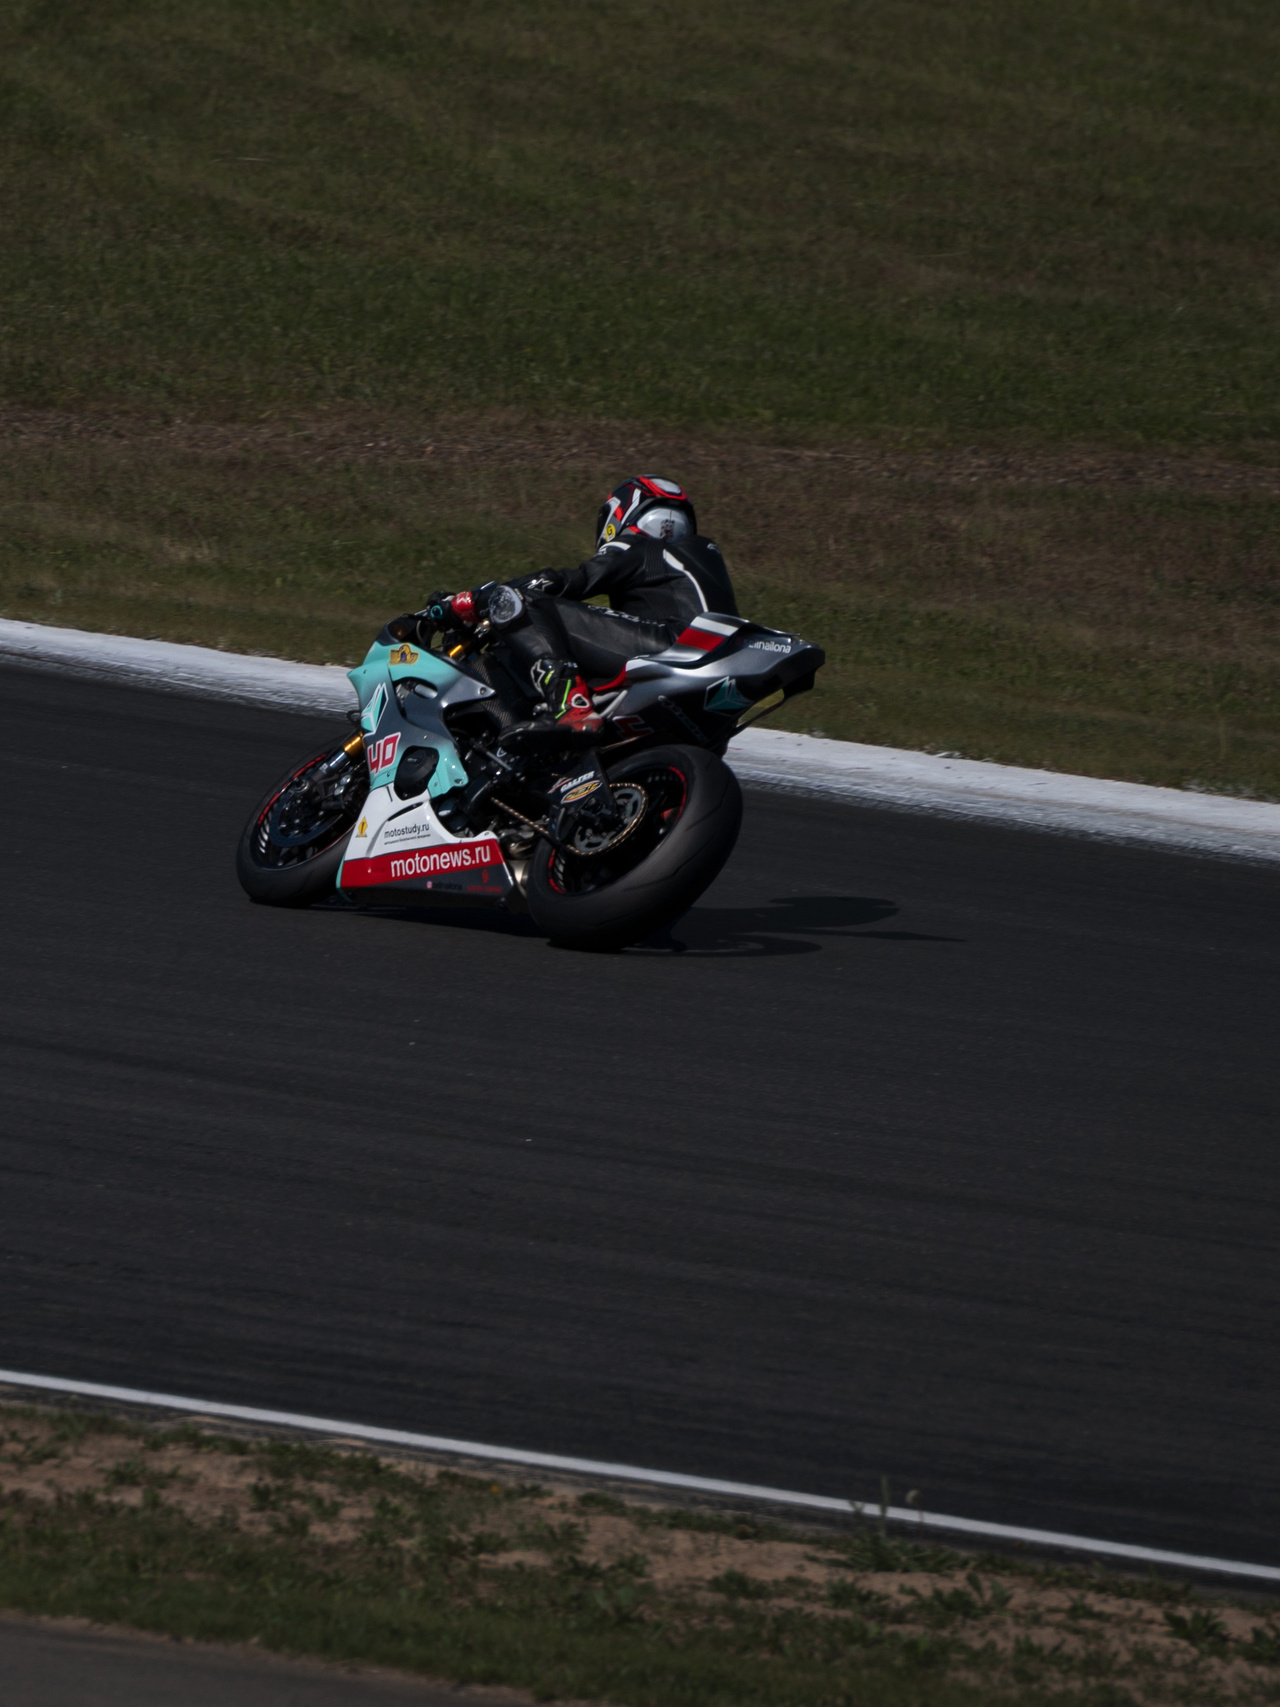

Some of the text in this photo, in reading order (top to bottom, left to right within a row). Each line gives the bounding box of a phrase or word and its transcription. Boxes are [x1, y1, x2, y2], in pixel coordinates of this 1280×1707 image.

[368, 733, 400, 775] 40
[384, 823, 430, 838] motostudy.ru
[390, 844, 492, 878] motonews.ru
